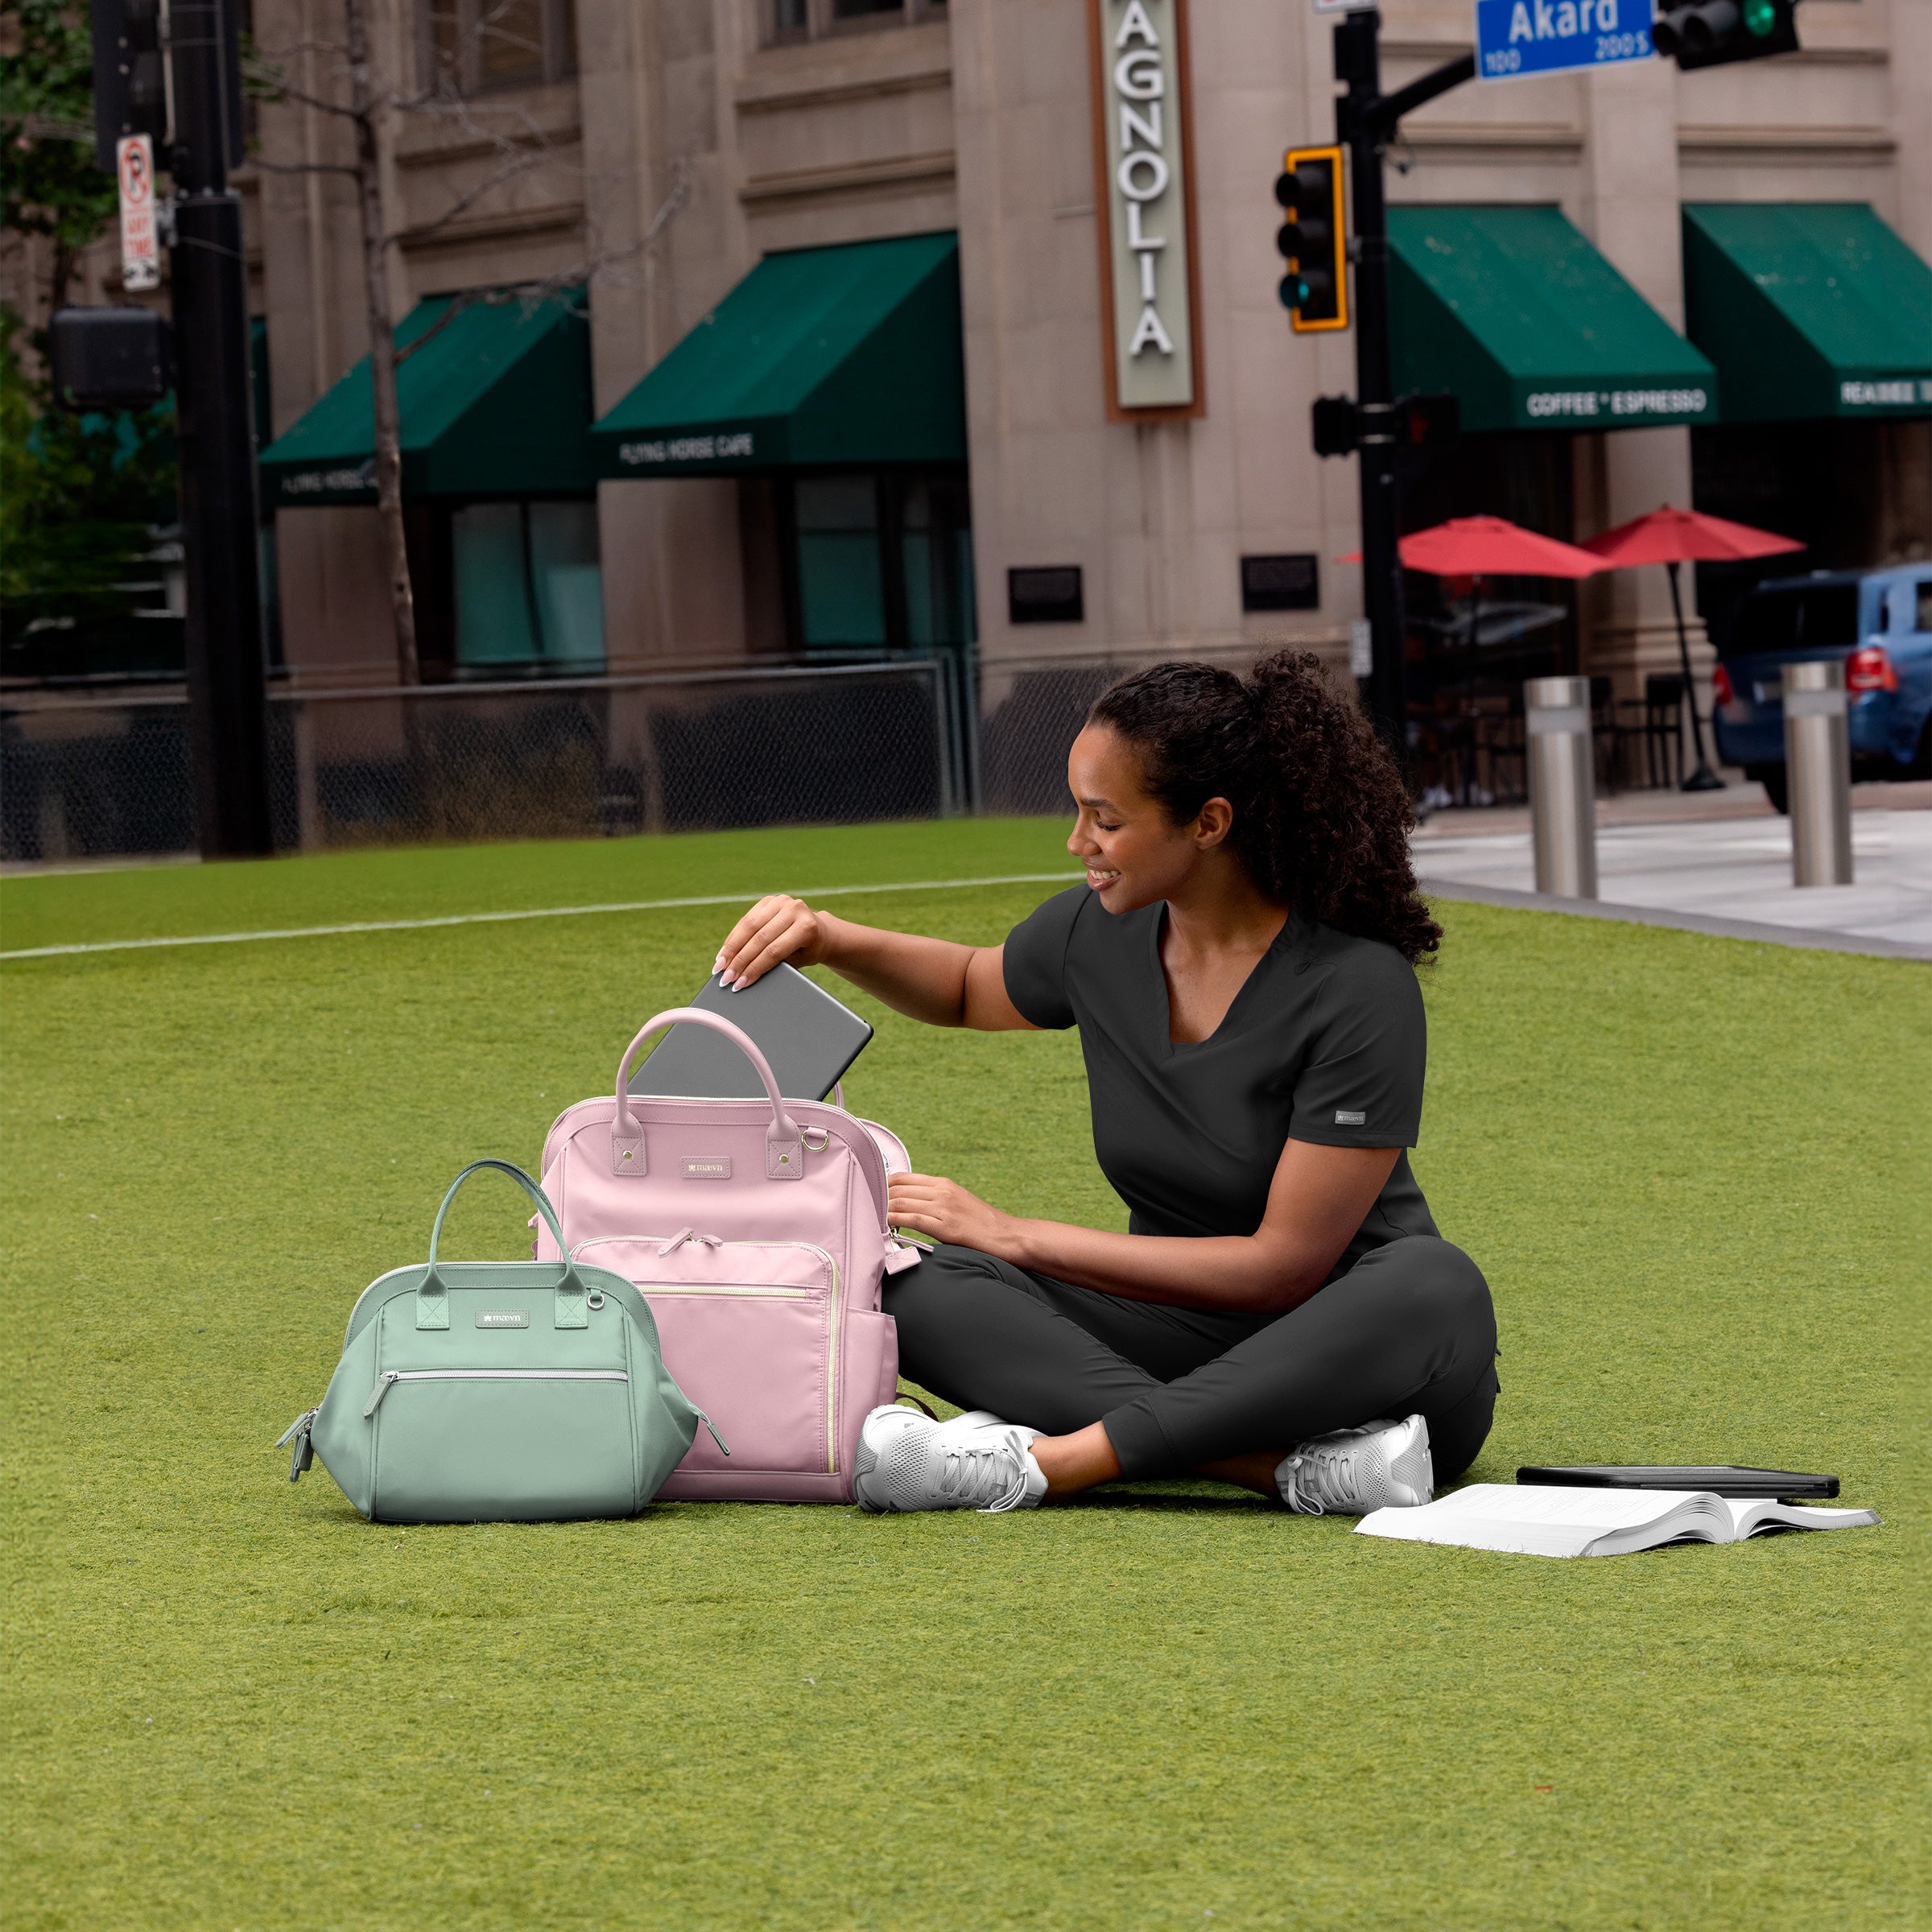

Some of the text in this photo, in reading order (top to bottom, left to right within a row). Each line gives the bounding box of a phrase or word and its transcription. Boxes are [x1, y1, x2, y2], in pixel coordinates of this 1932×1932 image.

[1509, 0, 1618, 43] Akard
[1486, 48, 1521, 74] 100
[1114, 0, 1173, 356] AGNOLIA
[1526, 388, 1707, 417] COFFEE ESPRESSO
